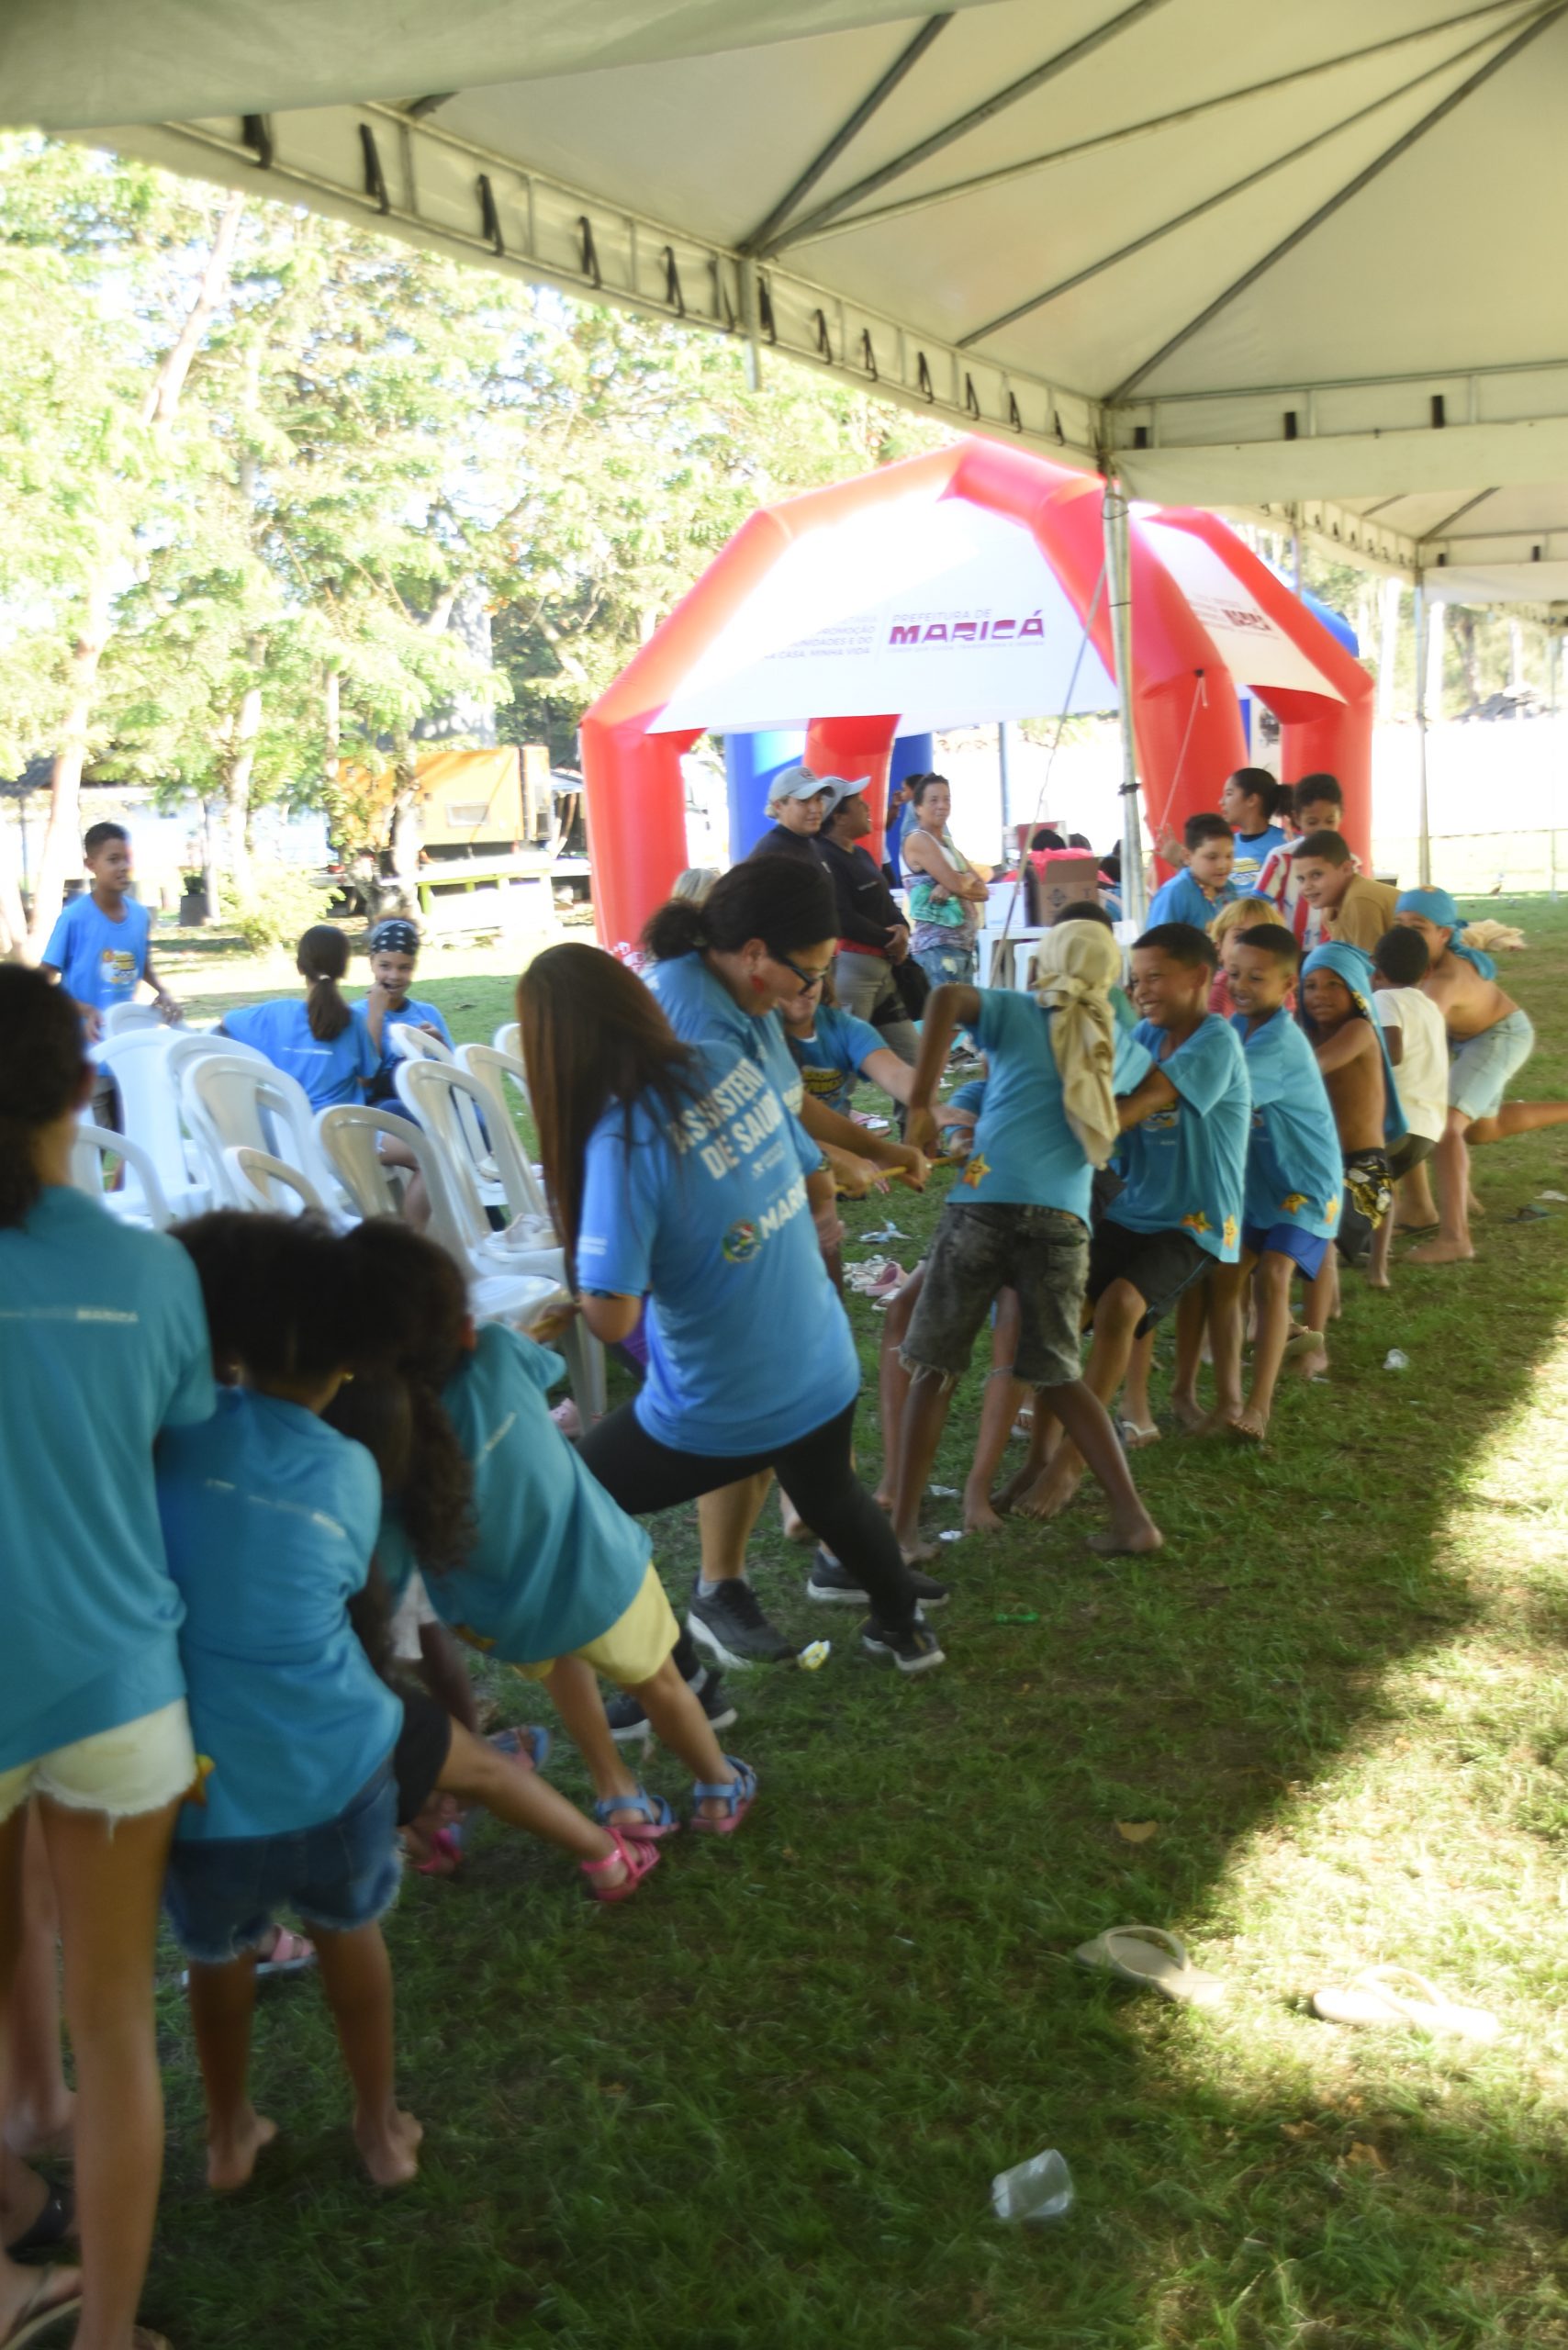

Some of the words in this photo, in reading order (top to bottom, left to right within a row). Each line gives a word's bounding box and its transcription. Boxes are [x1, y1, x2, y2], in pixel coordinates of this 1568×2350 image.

[889, 609, 1046, 644] MARICÁ
[975, 609, 992, 619] DE
[700, 1134, 740, 1180] DE
